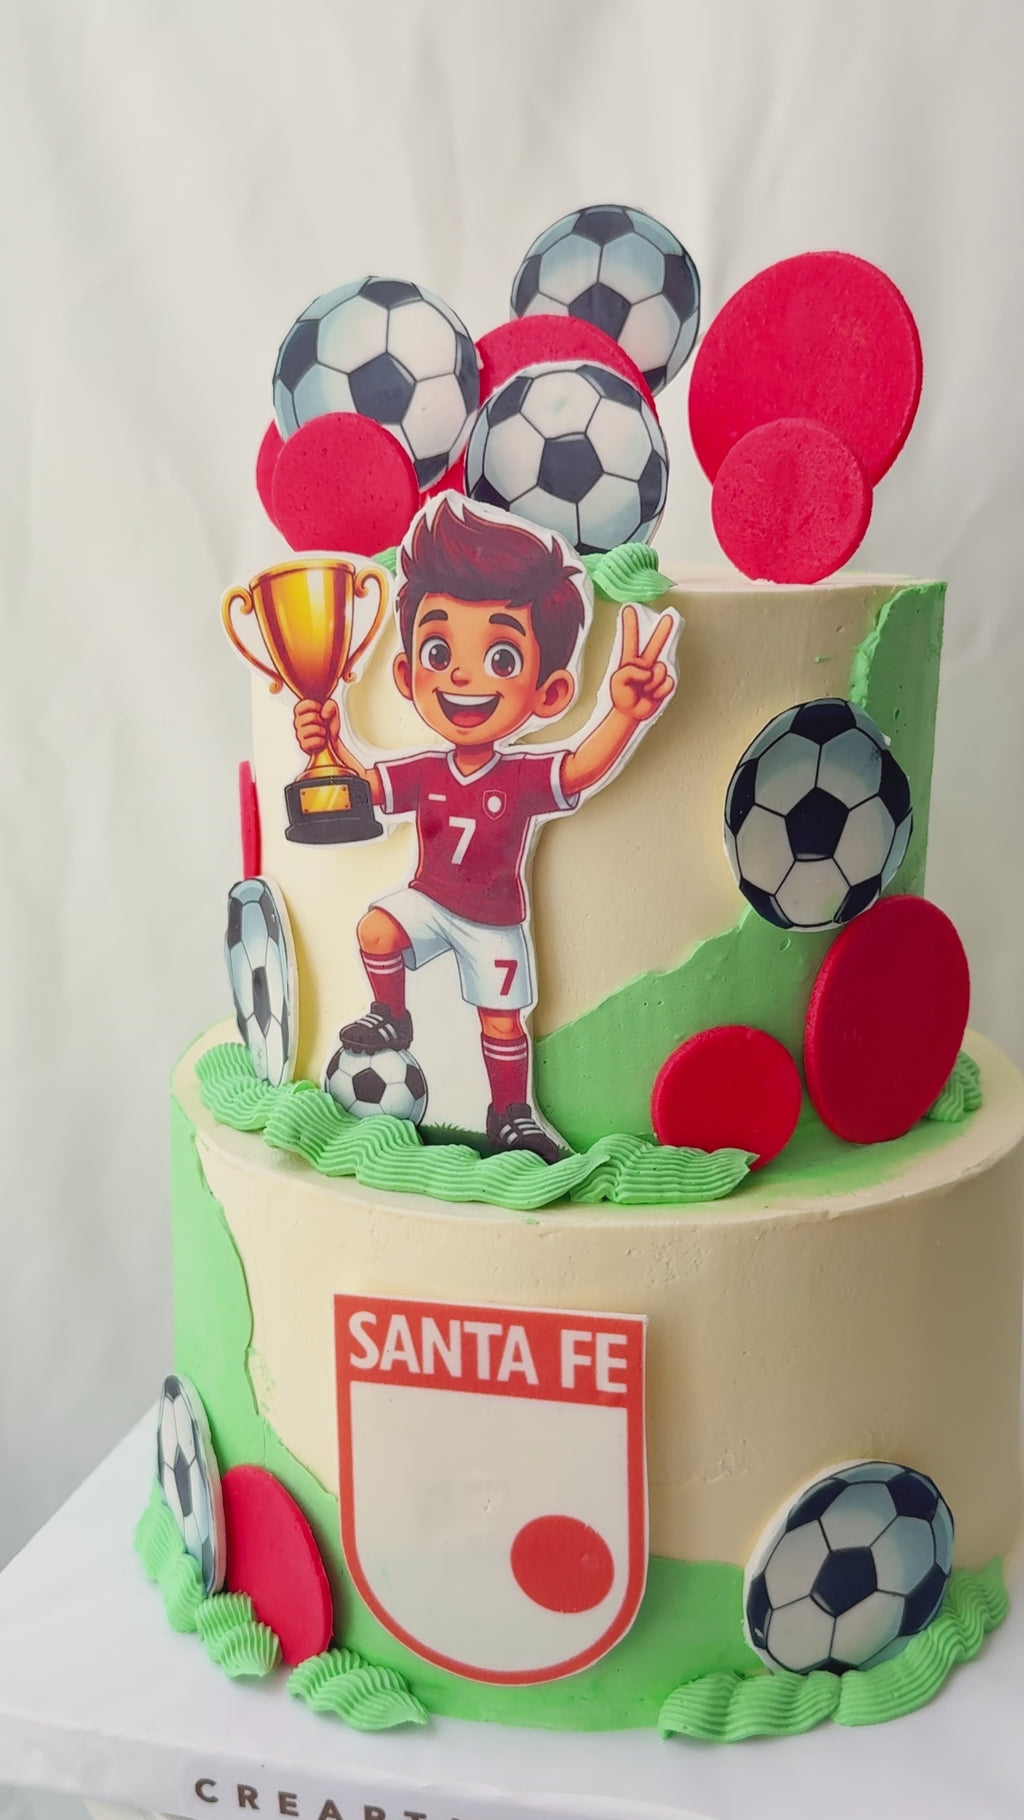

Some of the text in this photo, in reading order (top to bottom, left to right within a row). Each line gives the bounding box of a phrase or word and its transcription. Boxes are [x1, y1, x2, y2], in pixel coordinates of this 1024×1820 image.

[449, 816, 477, 865] 7
[494, 959, 518, 996] 7
[348, 1310, 628, 1394] SANTA FE
[194, 1778, 460, 1820] CREAR
